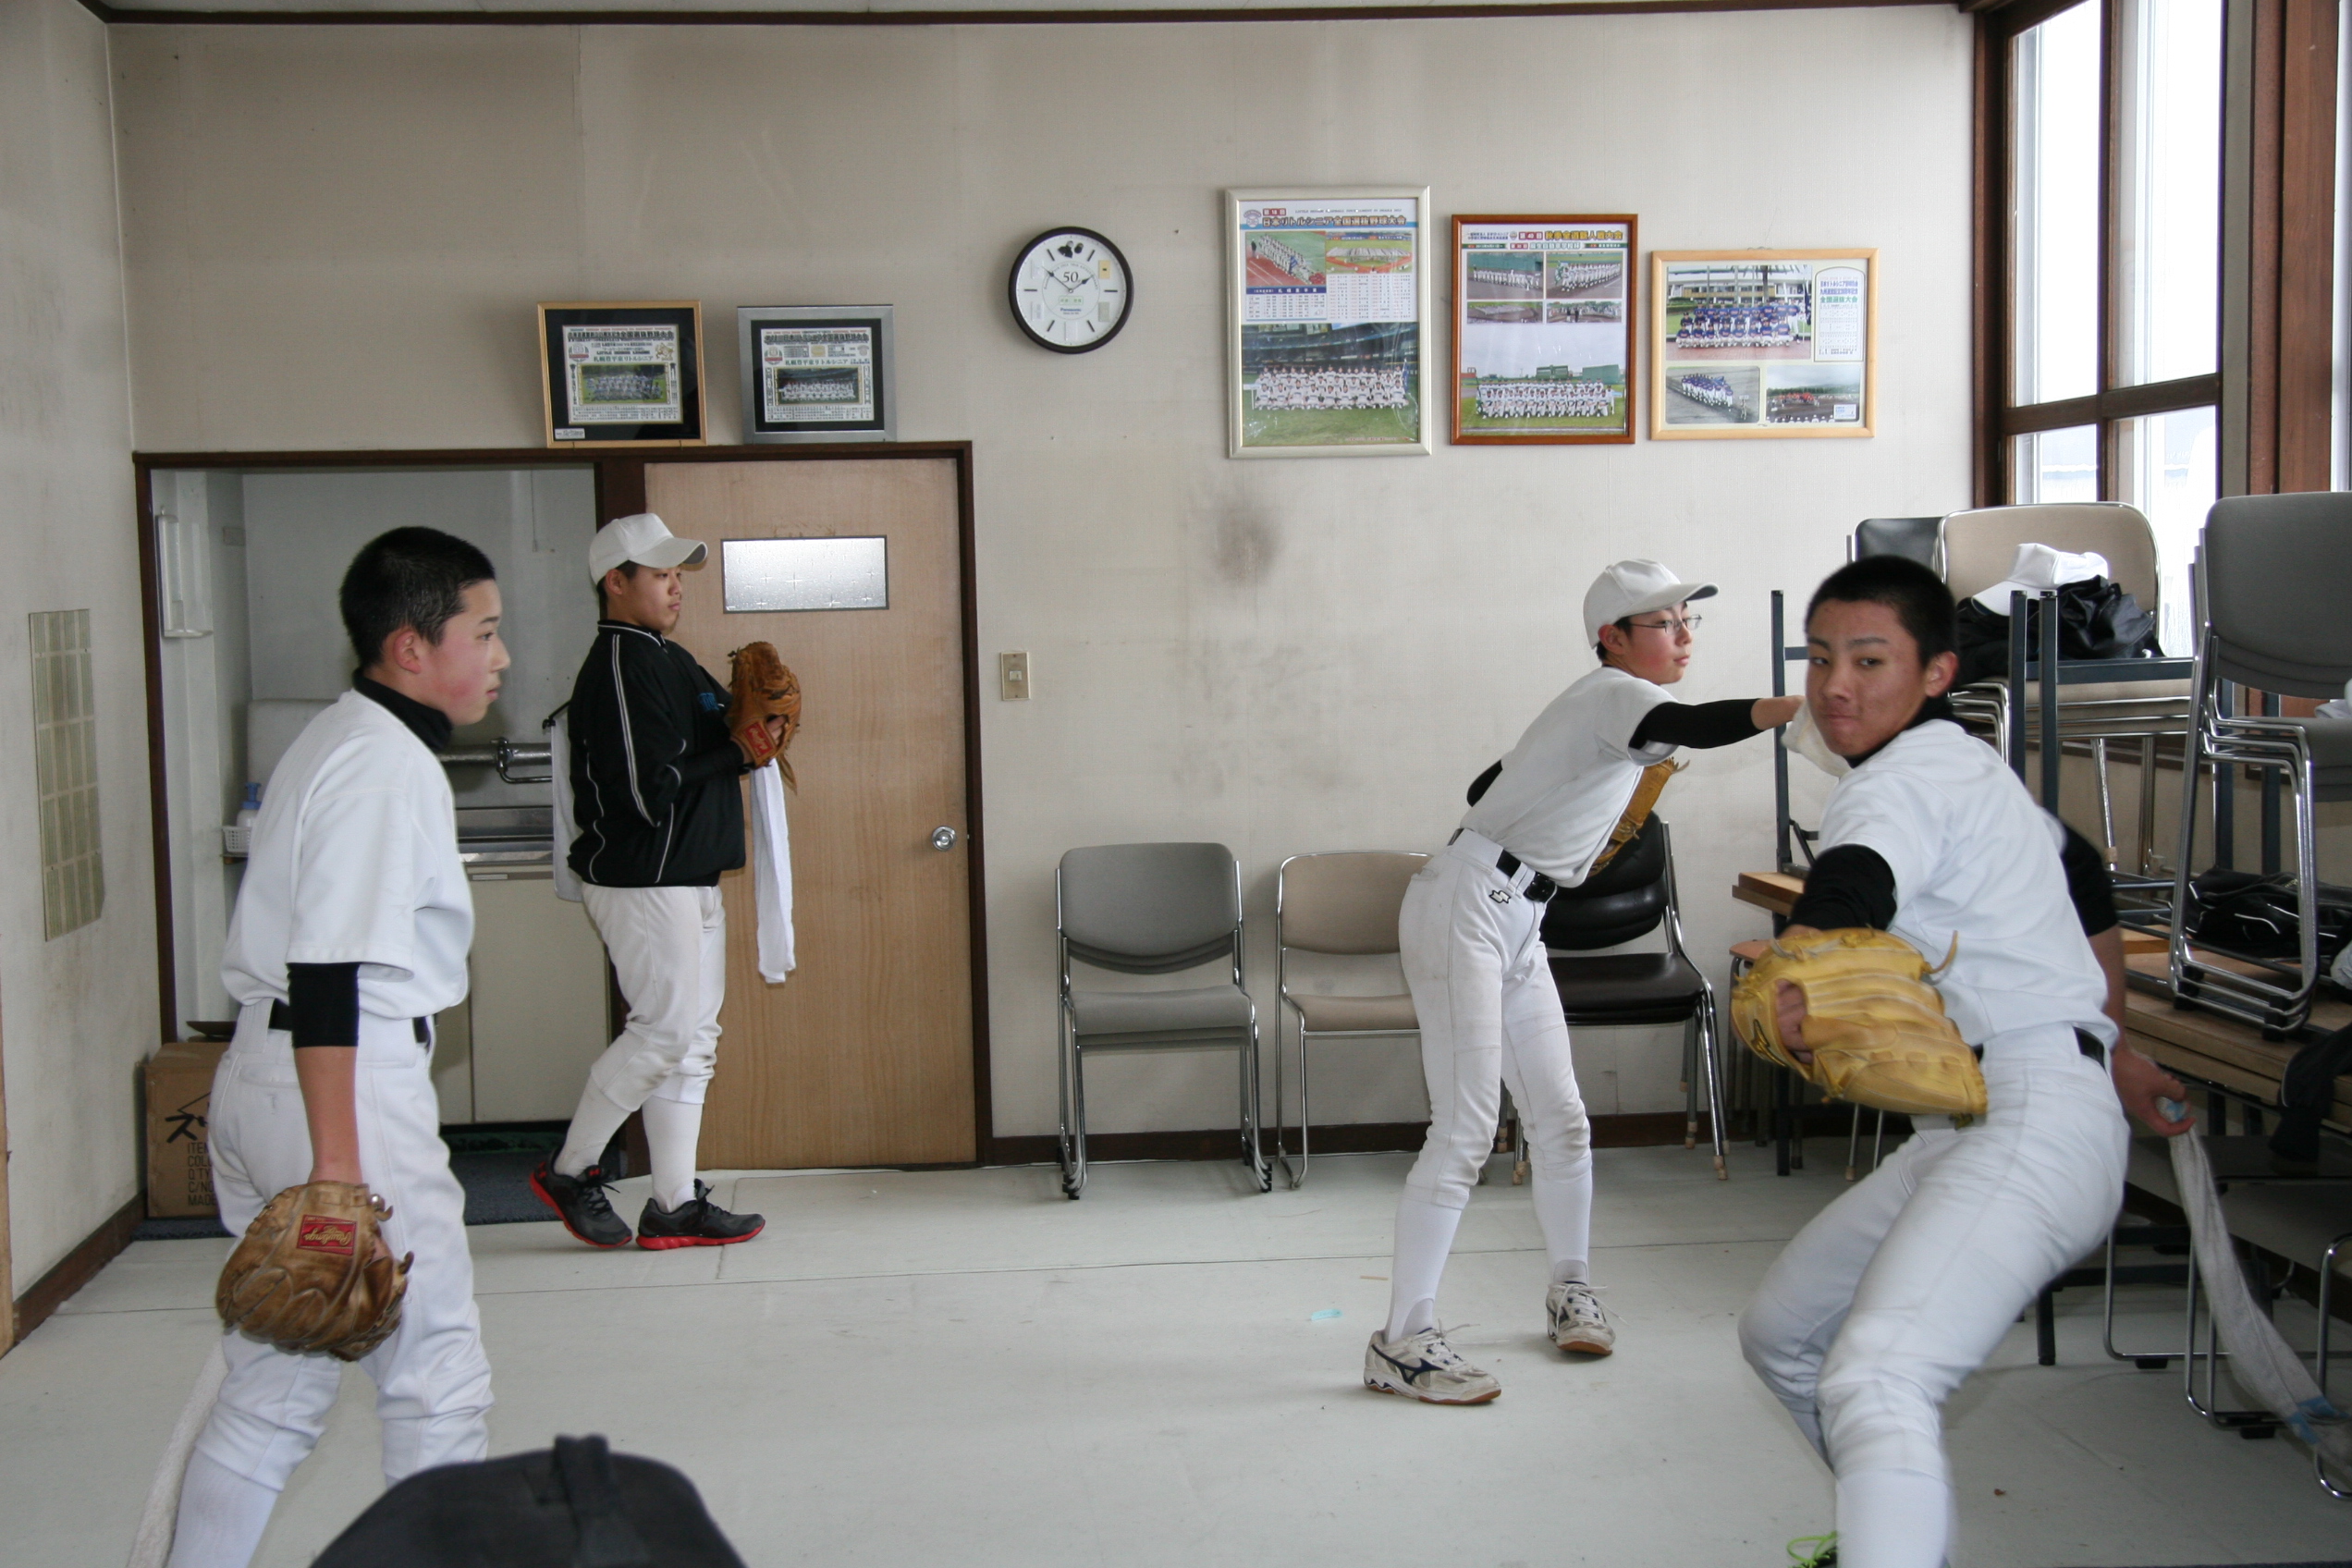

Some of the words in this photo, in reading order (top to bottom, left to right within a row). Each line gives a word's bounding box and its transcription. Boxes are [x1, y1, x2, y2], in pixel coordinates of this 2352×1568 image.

[1263, 215, 1406, 227] 日本リトルシニア全国選抜野球大会
[1063, 272, 1079, 283] 50
